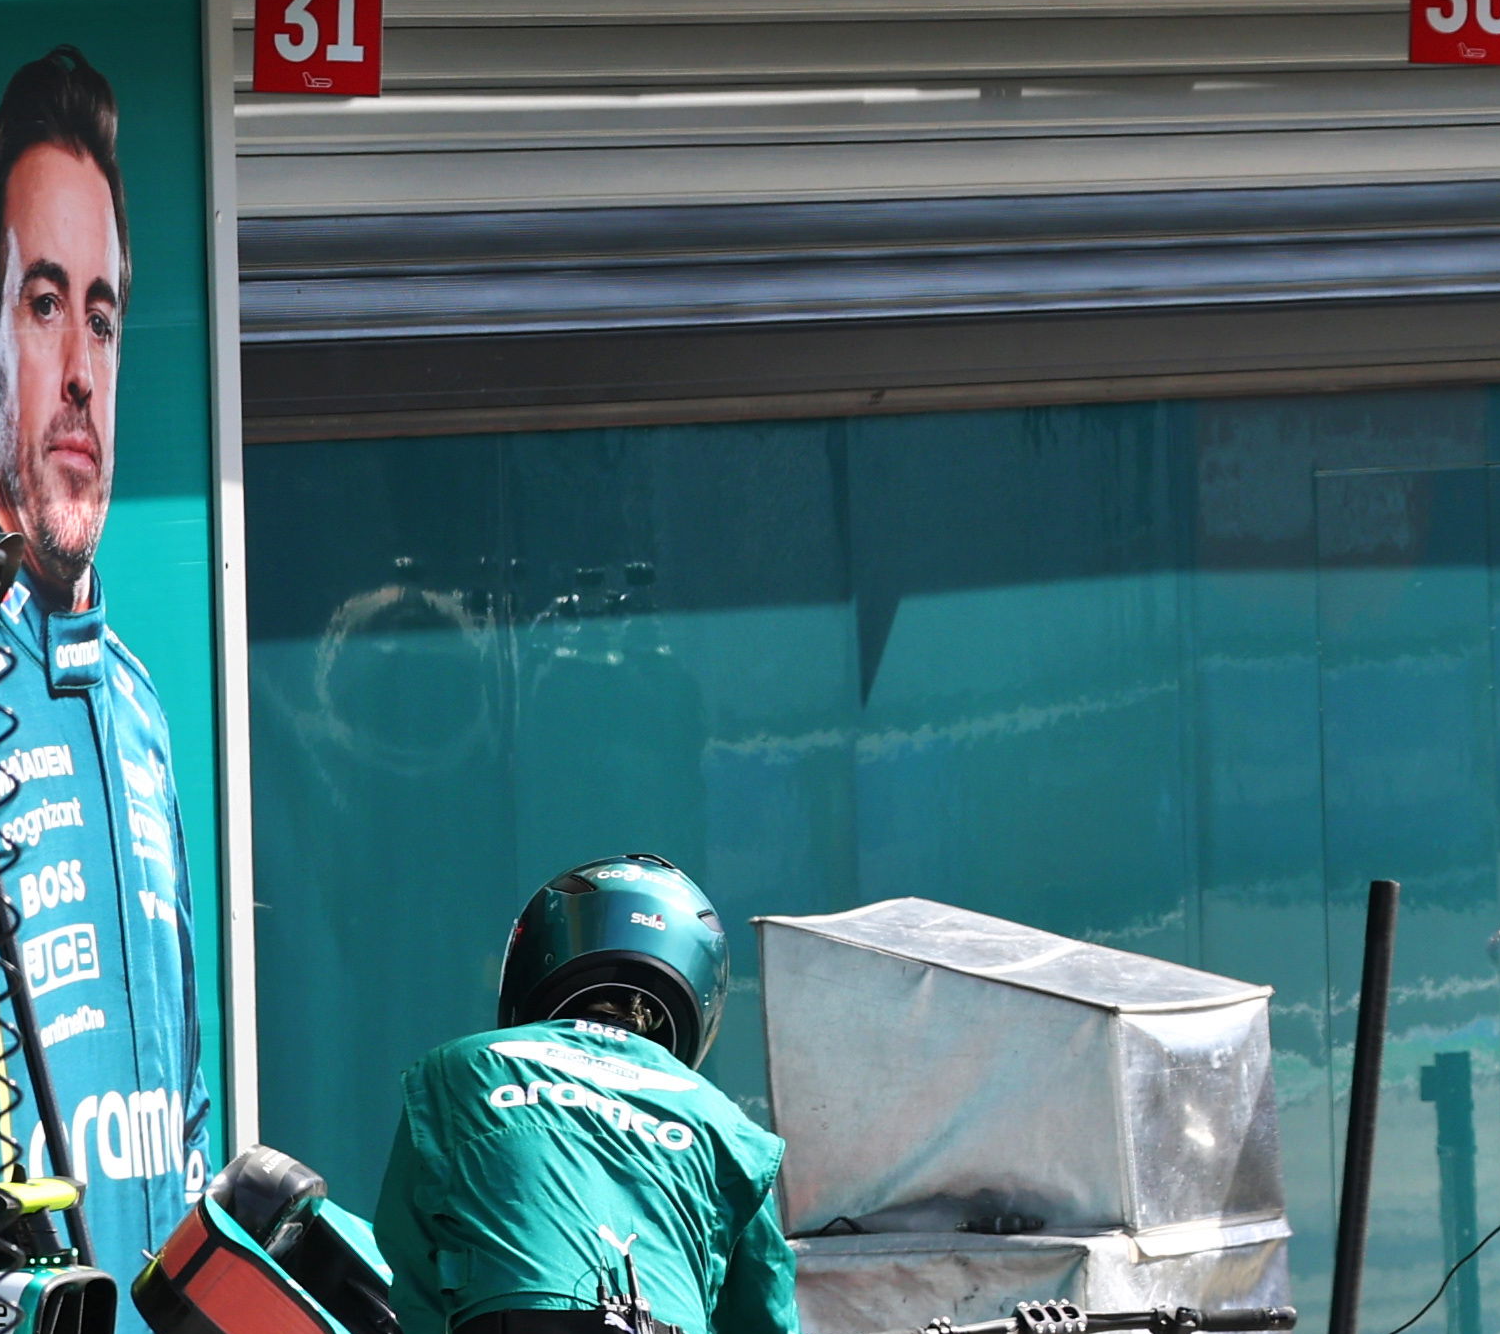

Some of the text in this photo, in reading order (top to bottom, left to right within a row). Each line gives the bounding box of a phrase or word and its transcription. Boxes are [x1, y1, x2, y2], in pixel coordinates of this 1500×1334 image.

[19, 859, 87, 919] BOSS
[30, 930, 94, 989] JCB
[573, 1019, 630, 1042] BOSS
[490, 1080, 694, 1151] aramco
